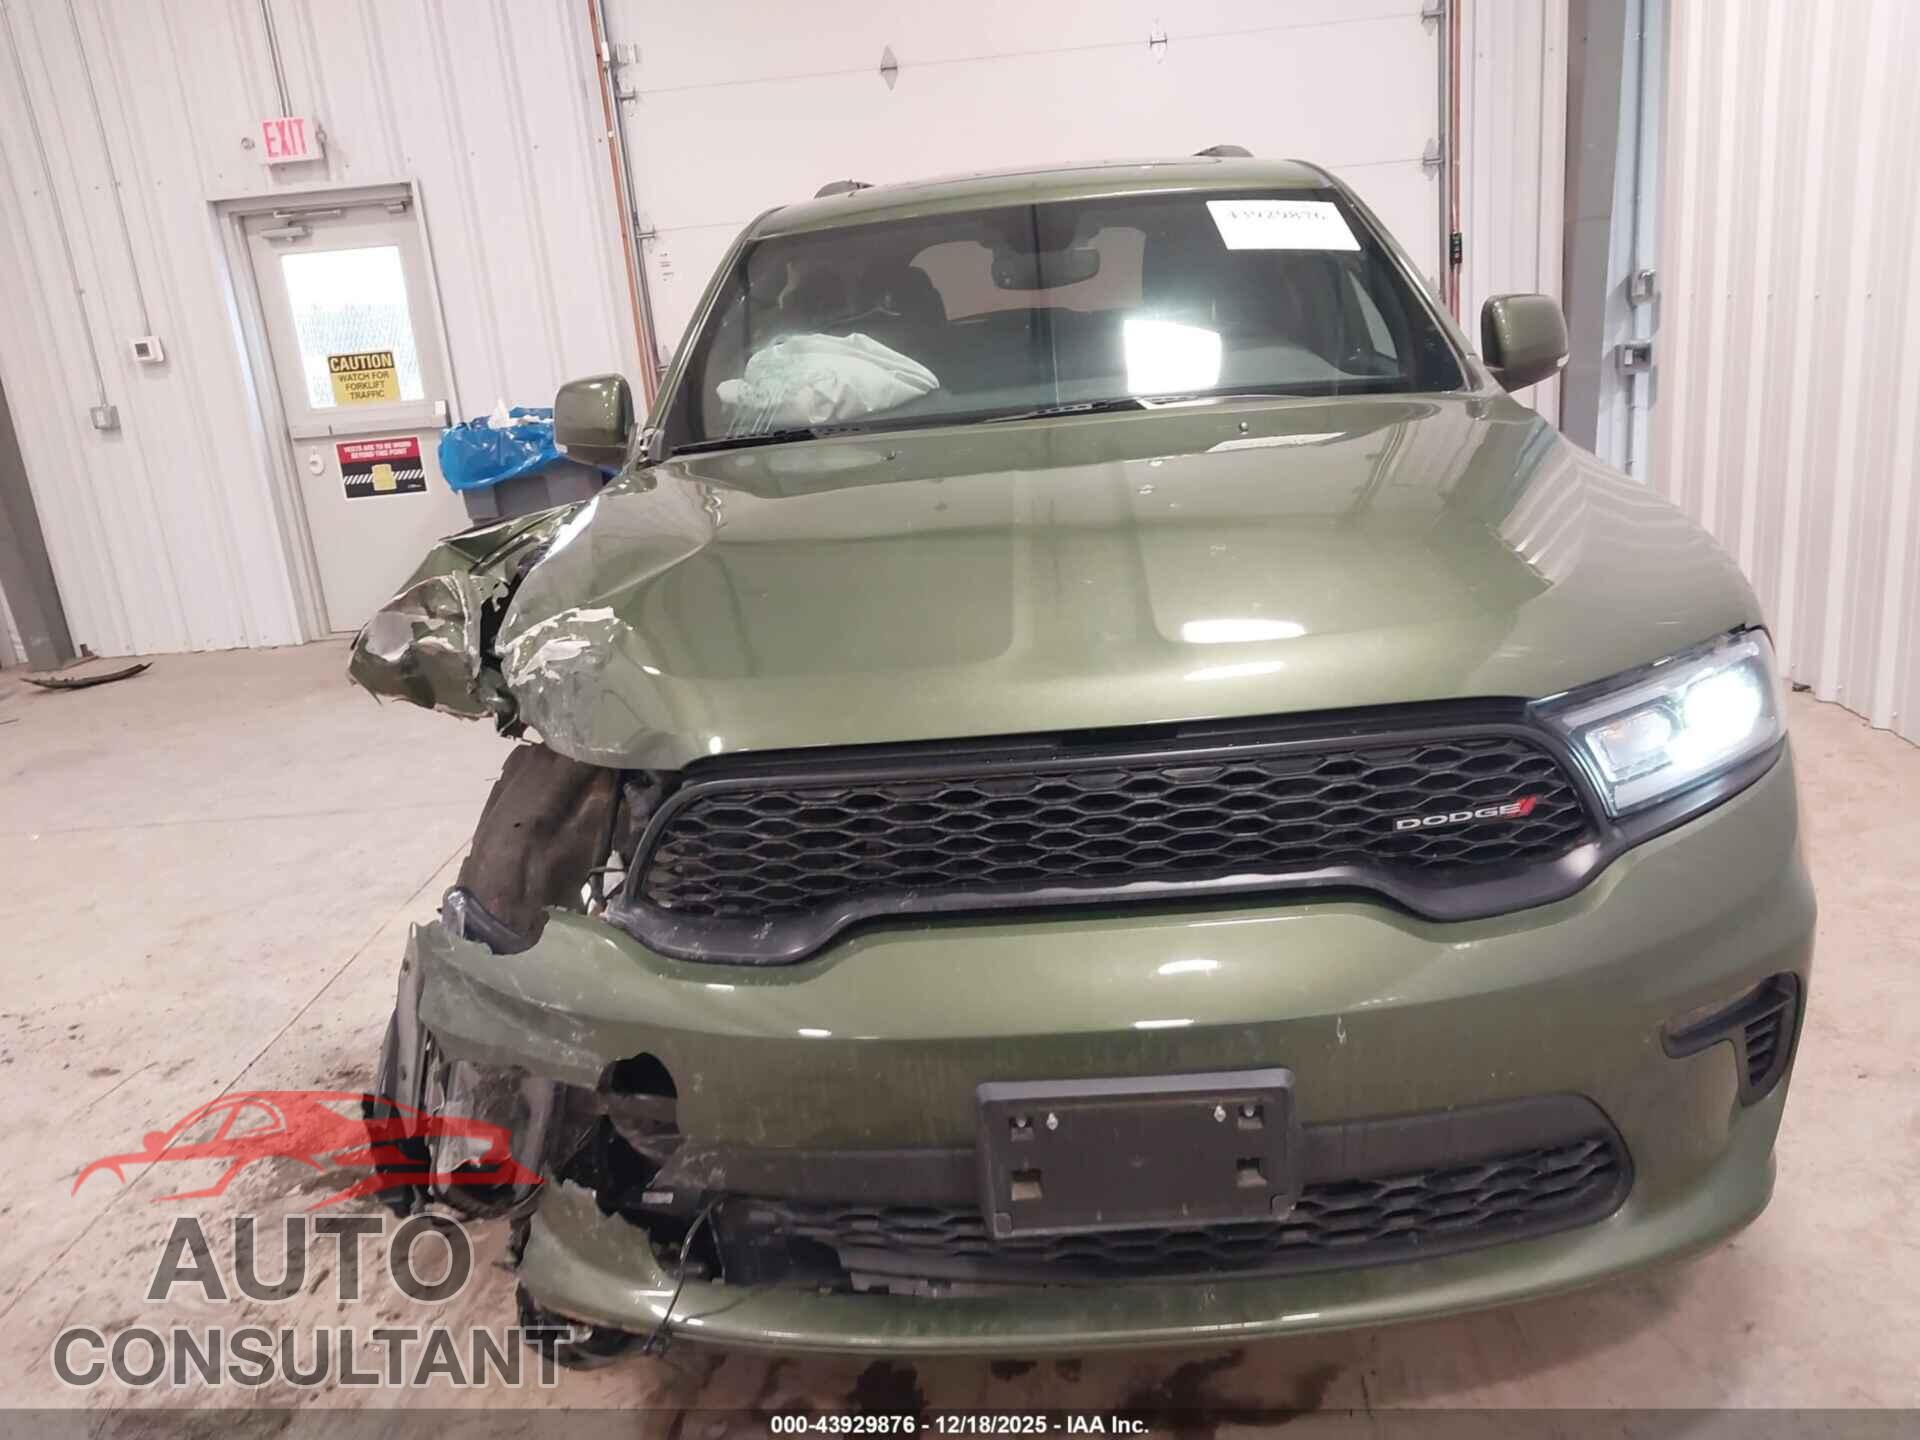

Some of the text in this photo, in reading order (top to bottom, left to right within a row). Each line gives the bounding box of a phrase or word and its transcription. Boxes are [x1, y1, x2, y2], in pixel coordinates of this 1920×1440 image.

[262, 118, 307, 158] EXIT
[330, 353, 392, 372] CAUTION
[338, 370, 390, 382] WATCH FOR
[345, 380, 385, 391] FORKLIFT
[350, 389, 385, 400] TRAFFIC
[1396, 803, 1521, 830] DODGE
